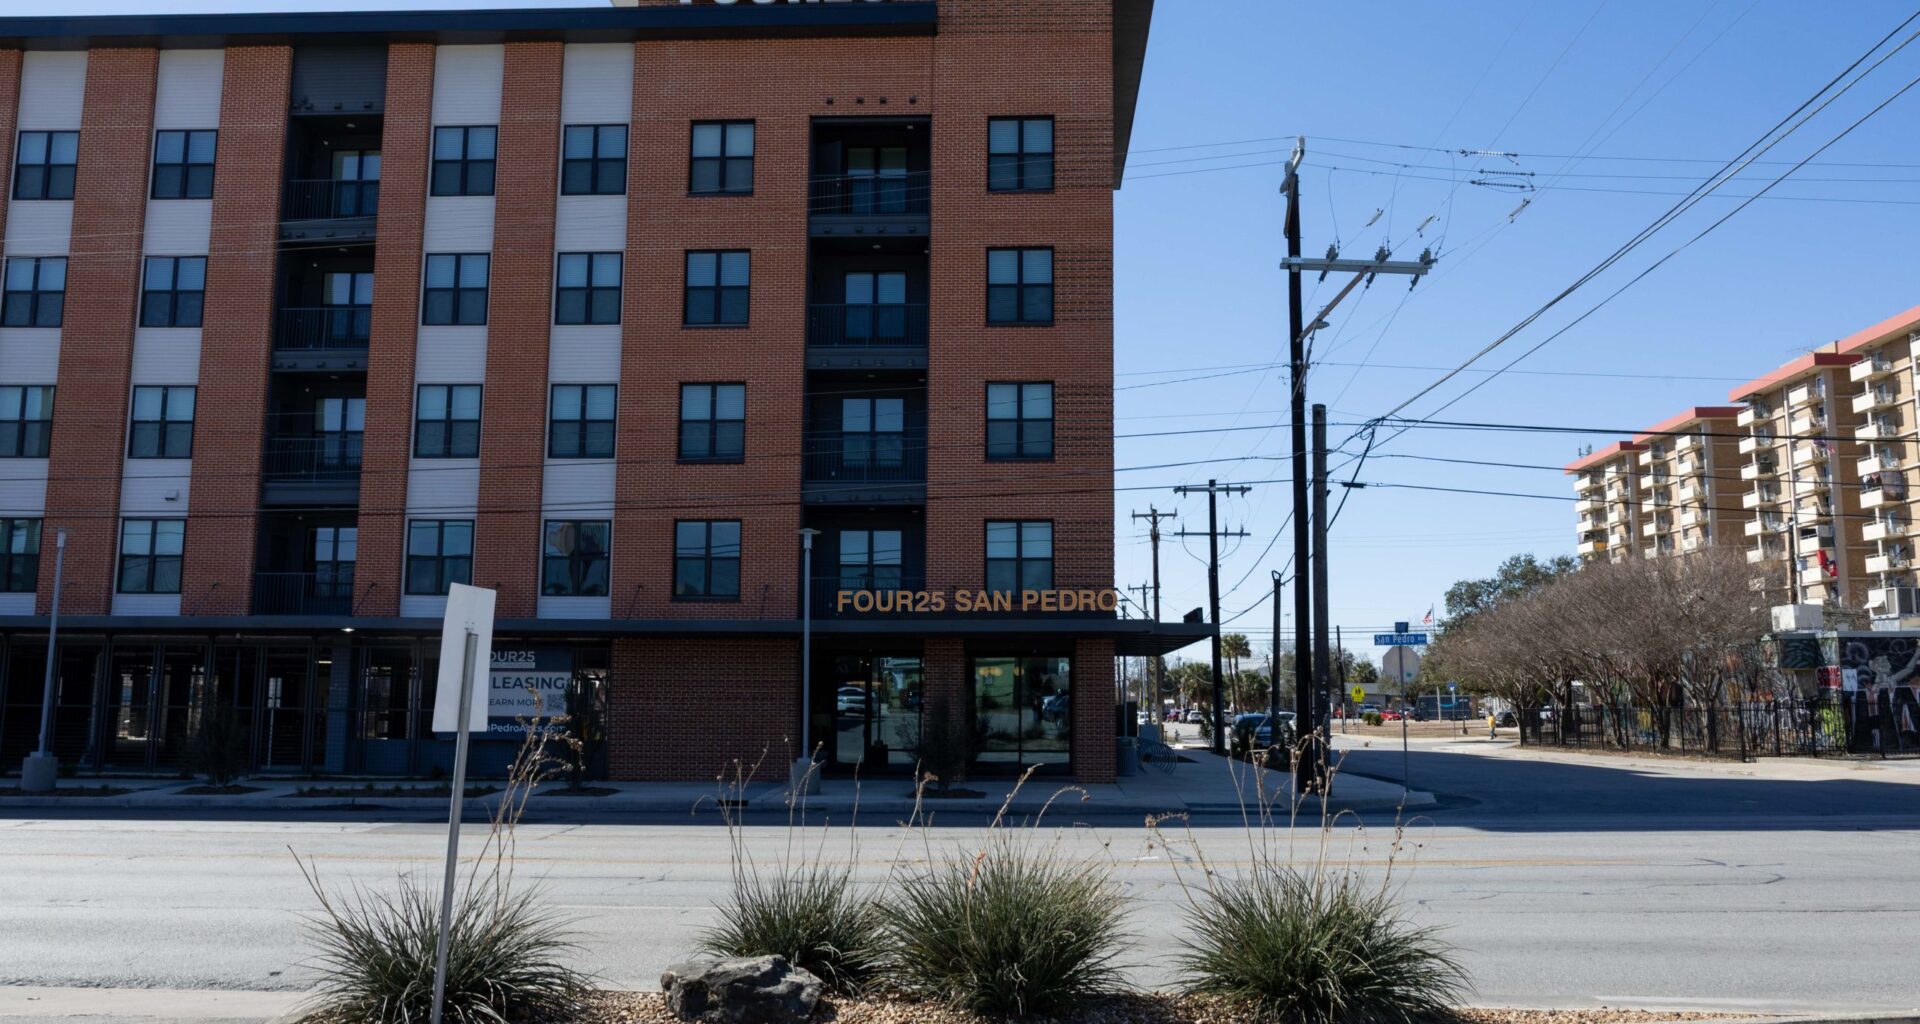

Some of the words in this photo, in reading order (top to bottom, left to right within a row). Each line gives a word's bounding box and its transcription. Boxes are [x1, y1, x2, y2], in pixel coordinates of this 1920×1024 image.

[837, 590, 946, 612] FOUR25
[955, 590, 1012, 612] SAN
[1023, 590, 1119, 612] PEDRO
[1376, 634, 1390, 644] San
[1392, 634, 1415, 644] Pedro
[490, 651, 536, 662] OUR25
[493, 677, 565, 689] LEASING
